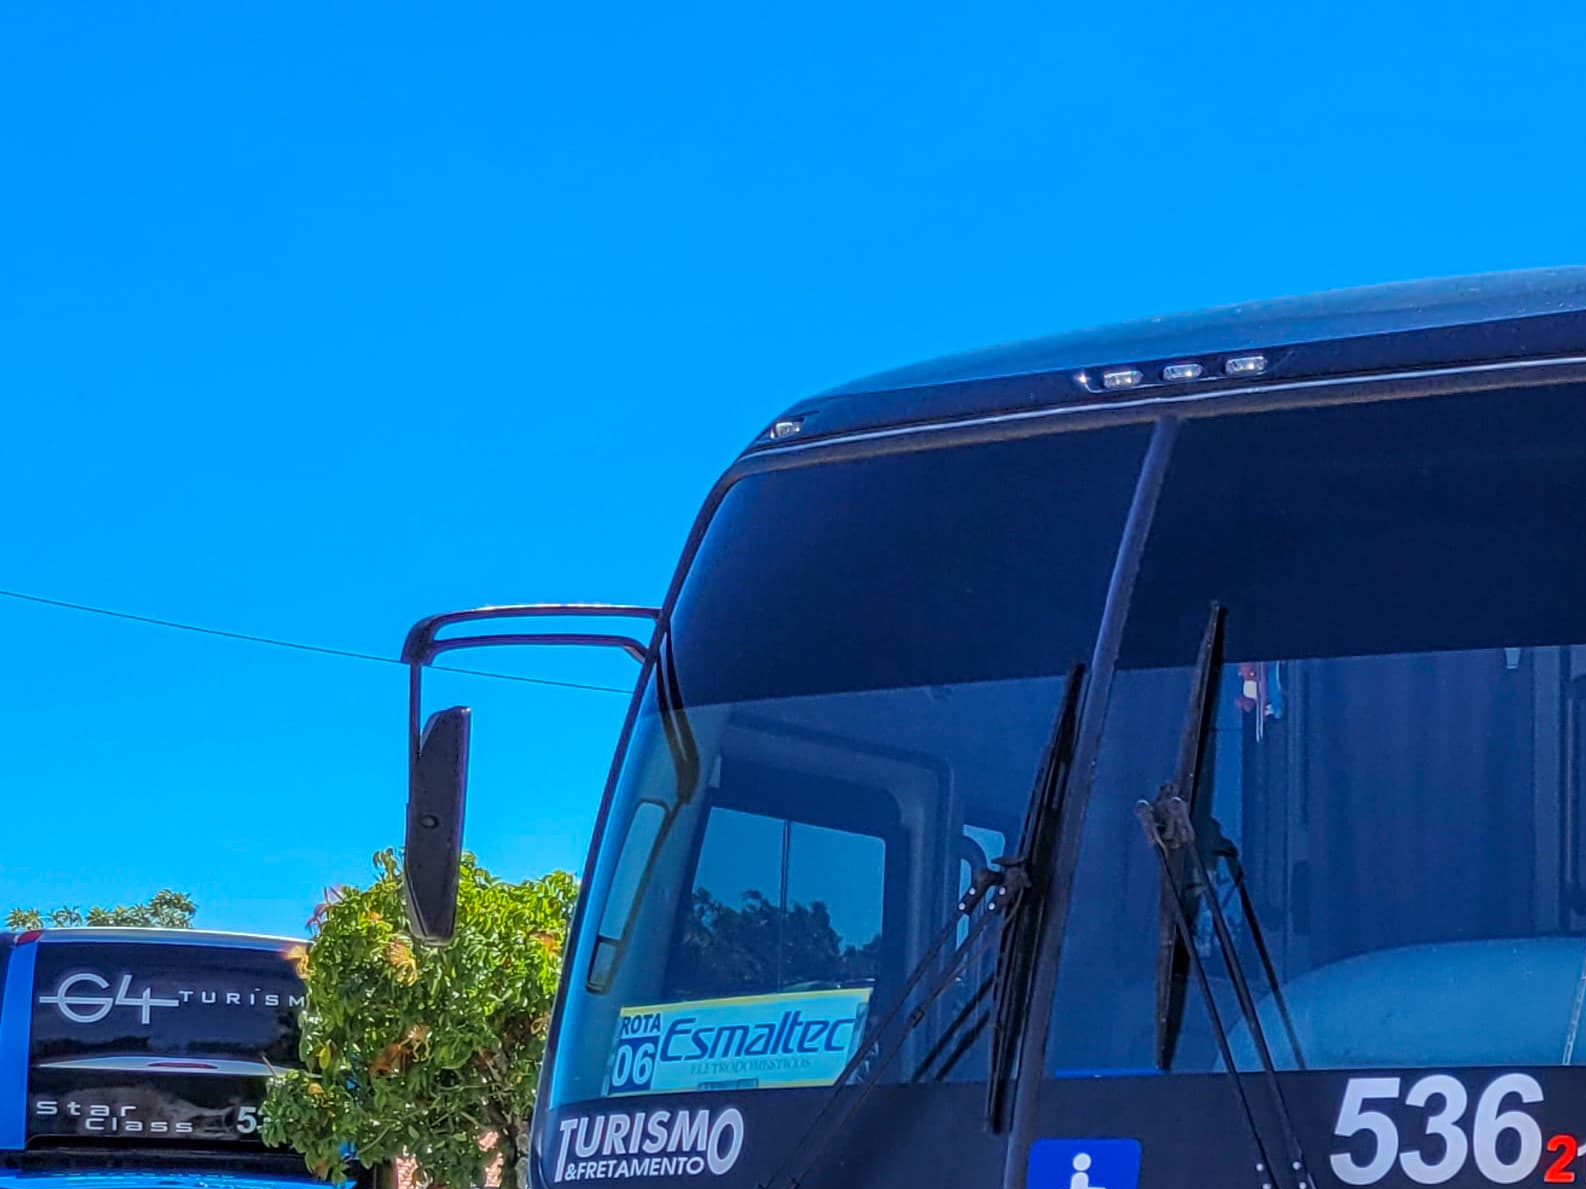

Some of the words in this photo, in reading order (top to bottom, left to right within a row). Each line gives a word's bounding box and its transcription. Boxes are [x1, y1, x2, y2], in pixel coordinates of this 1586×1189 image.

[39, 973, 179, 1024] G4
[179, 989, 306, 1008] TURISM
[620, 1013, 661, 1036] ROTA
[659, 1010, 856, 1062] Esmaltec
[611, 1043, 656, 1088] 06
[36, 1101, 137, 1117] Star
[85, 1117, 193, 1133] Class
[554, 1108, 744, 1183] TURISMO
[565, 1156, 705, 1181] &FRETAMENTO
